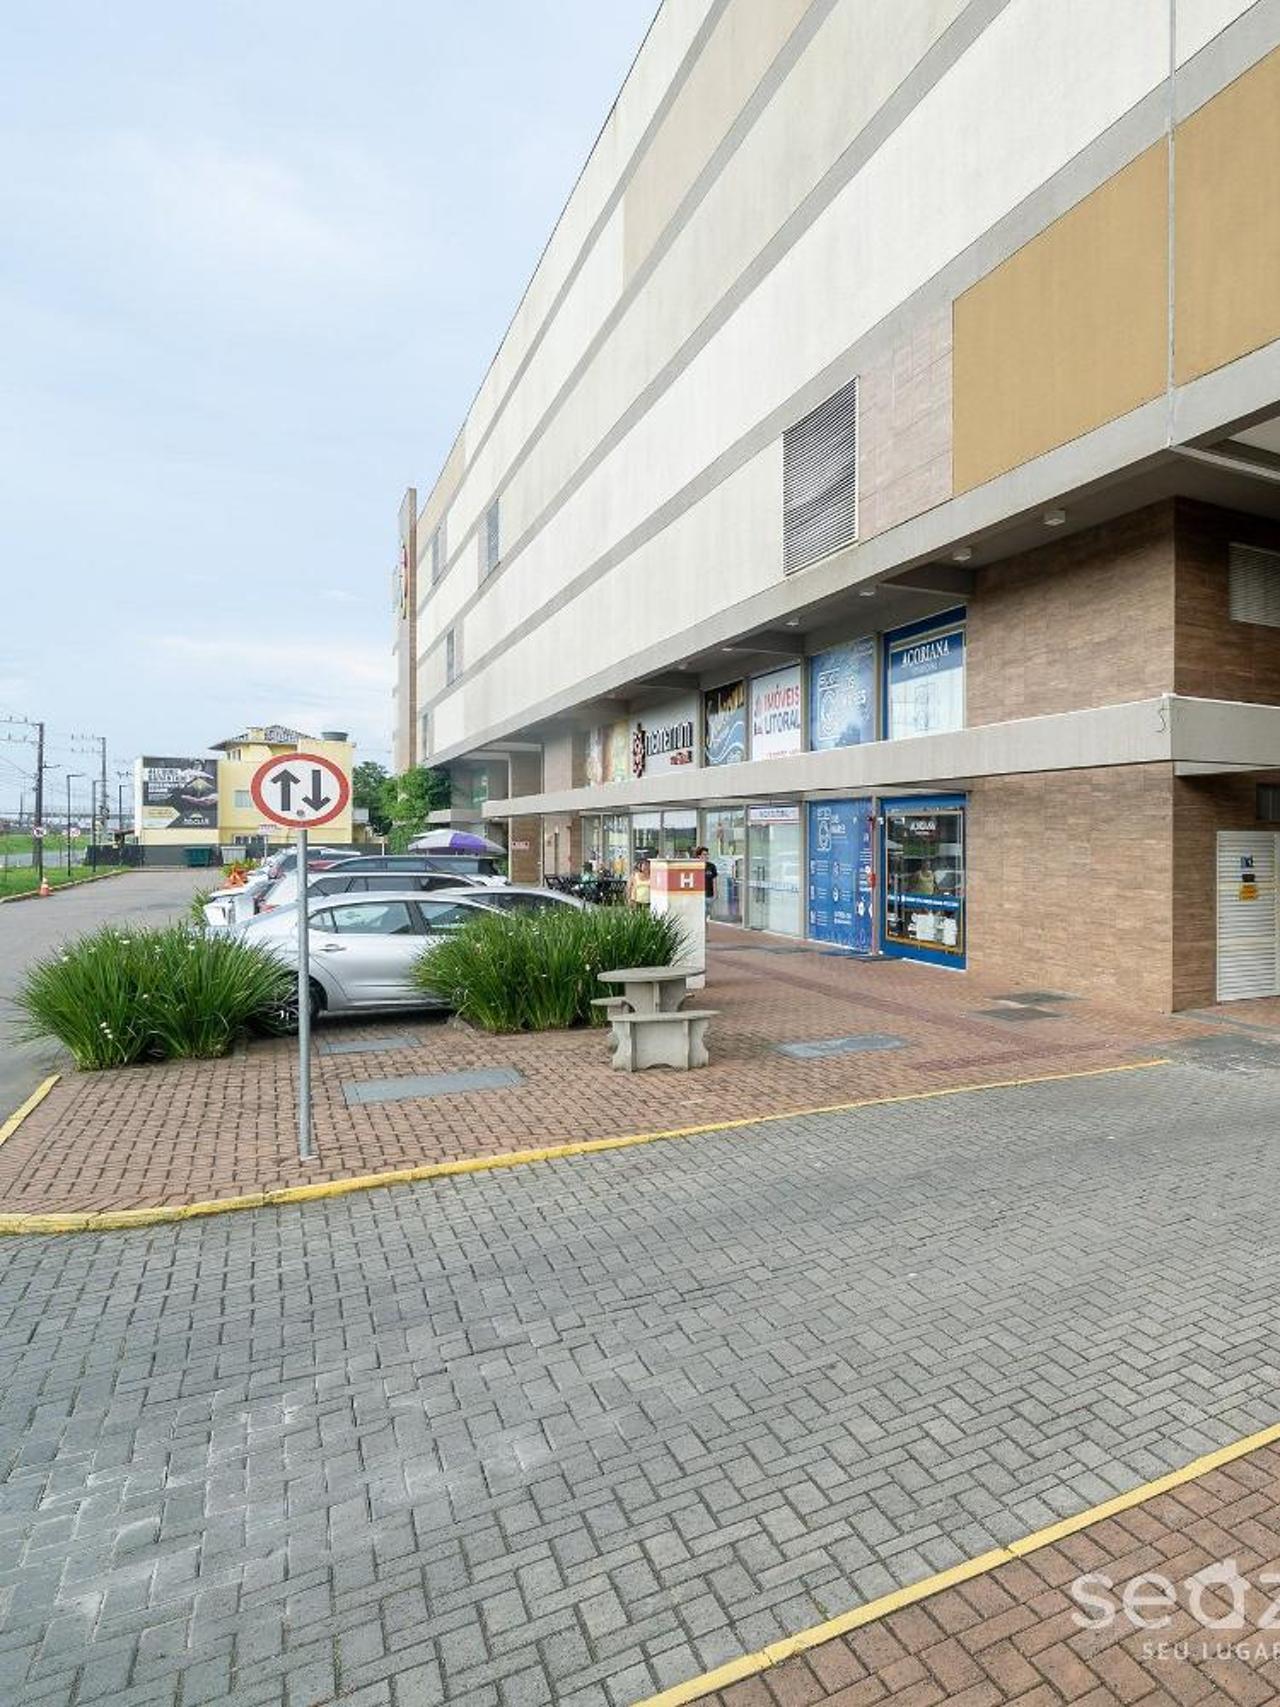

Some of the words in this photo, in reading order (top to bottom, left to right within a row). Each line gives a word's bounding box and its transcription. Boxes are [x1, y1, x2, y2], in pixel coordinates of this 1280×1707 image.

[764, 683, 800, 711] IMÓVEIS
[764, 710, 800, 734] LITORAL
[680, 872, 694, 888] H
